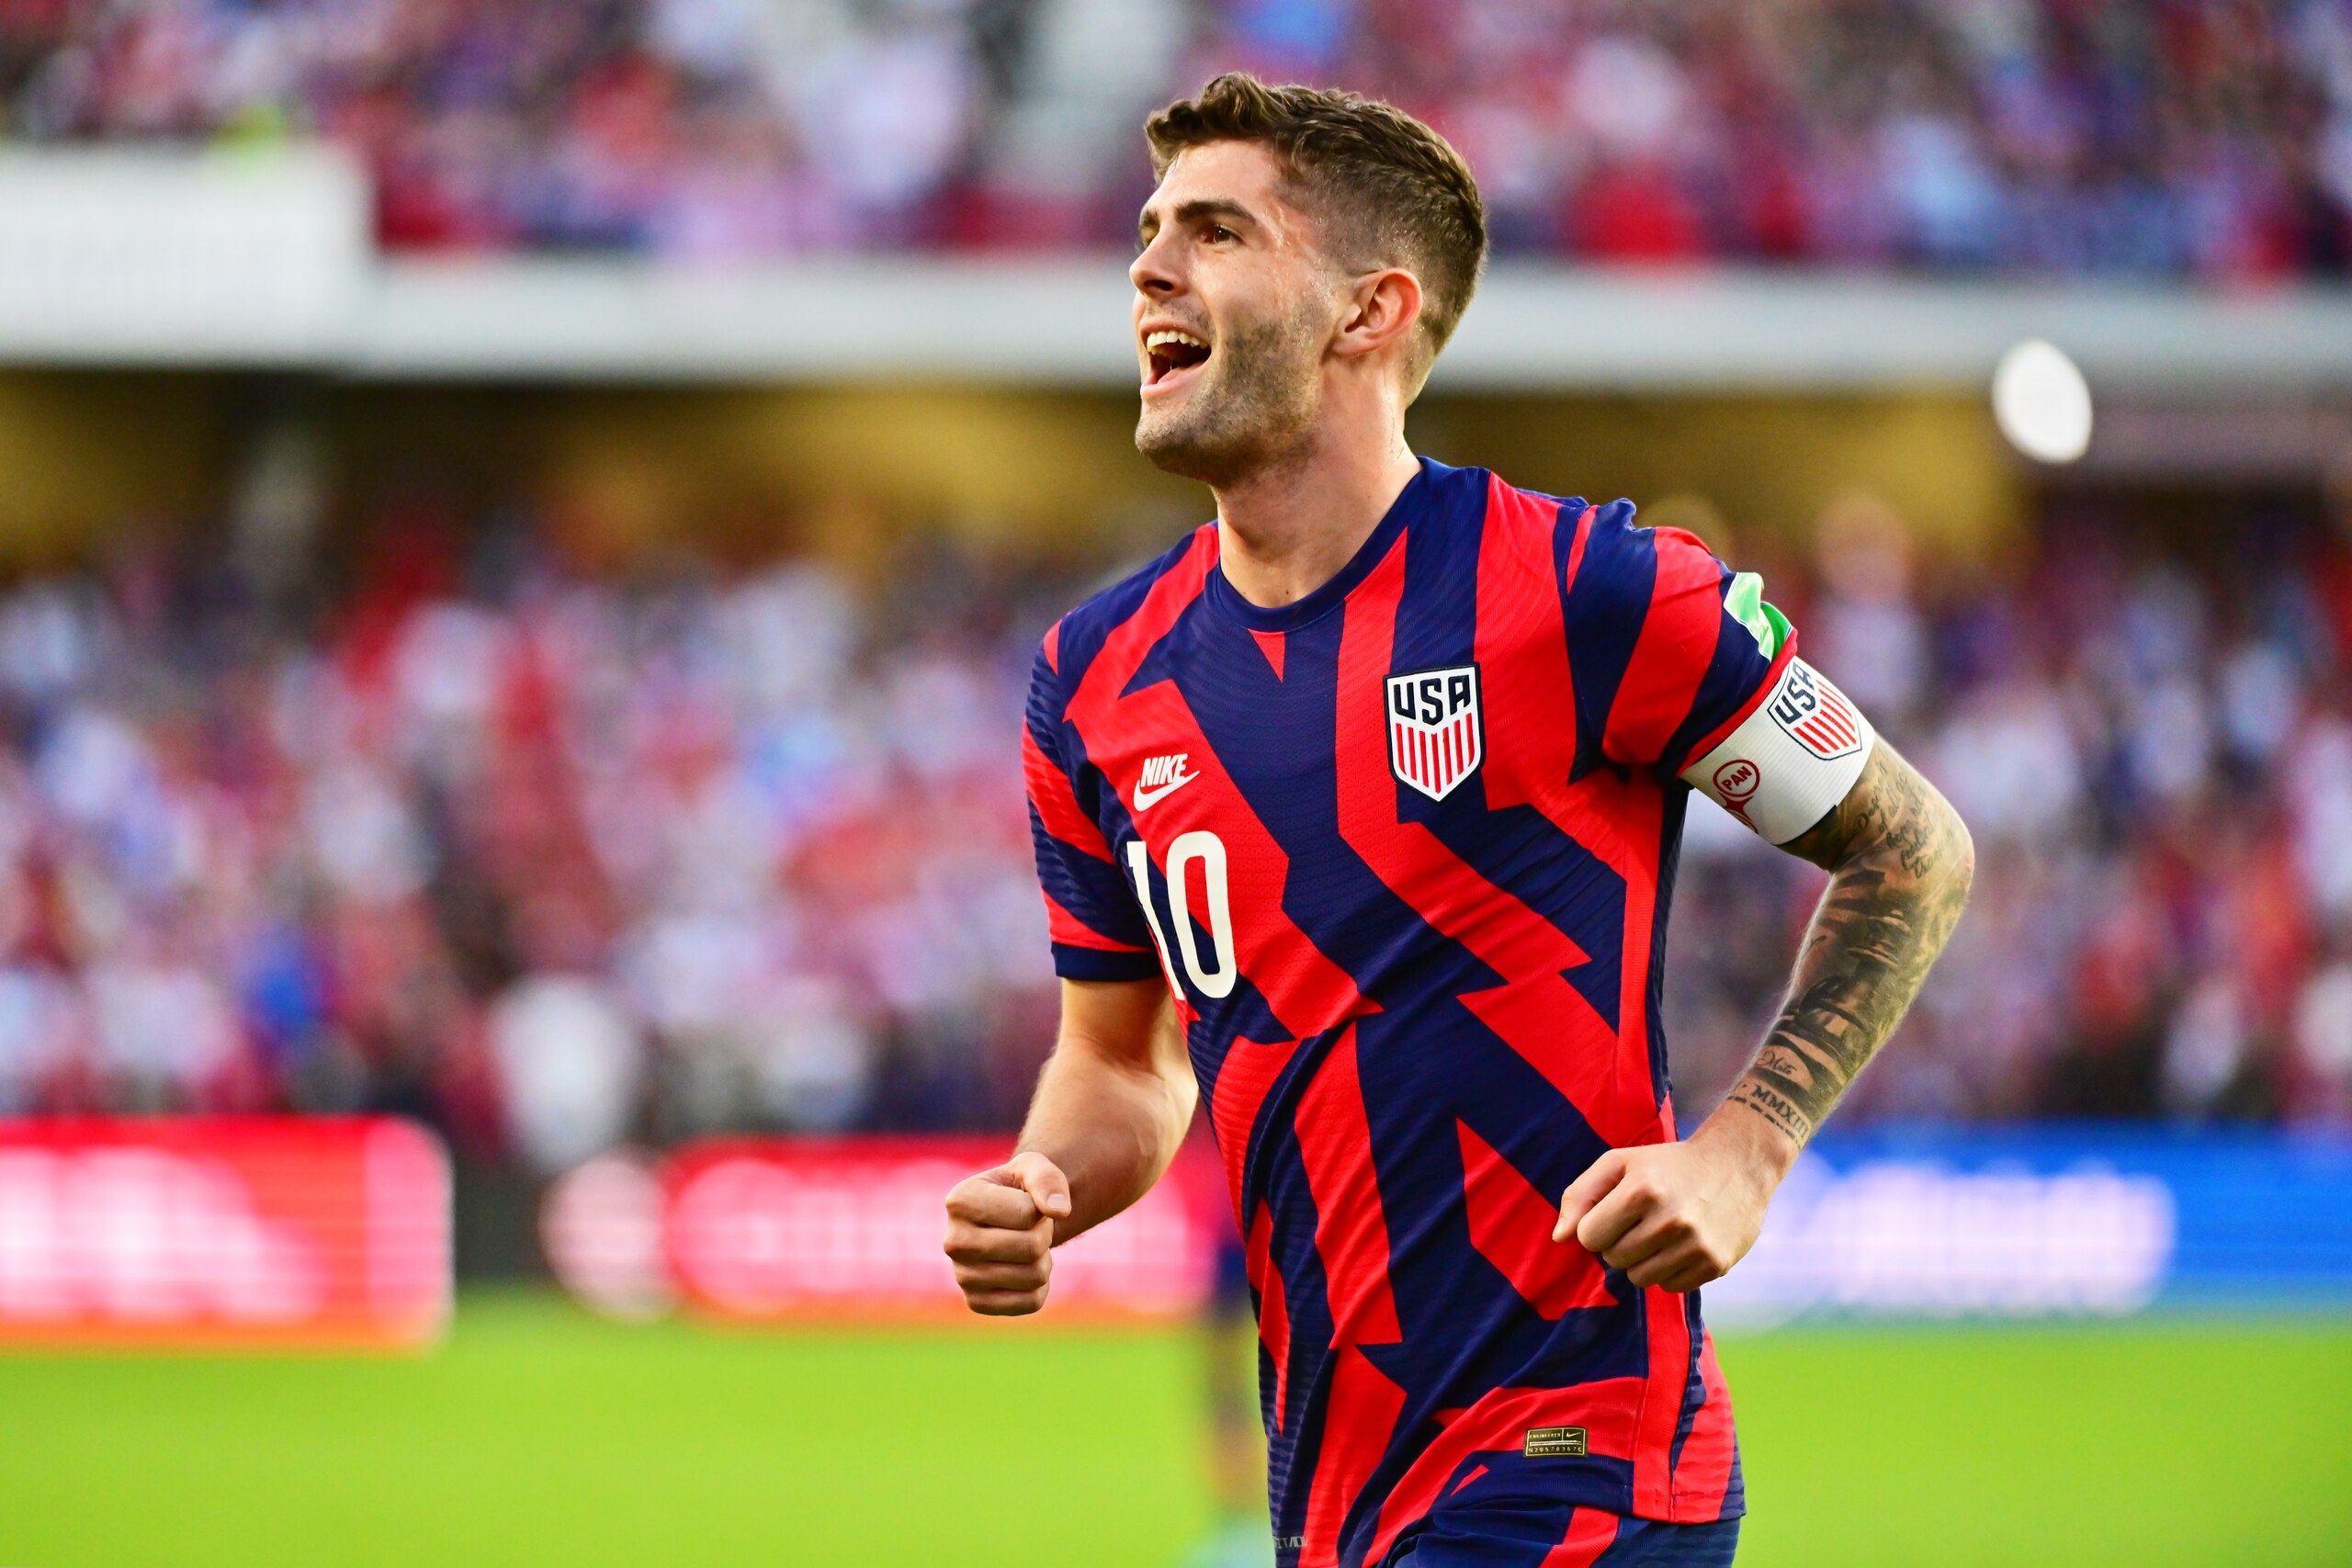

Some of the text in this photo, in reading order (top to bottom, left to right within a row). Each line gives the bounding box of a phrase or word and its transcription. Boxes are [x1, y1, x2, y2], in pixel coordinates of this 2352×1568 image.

[1393, 674, 1471, 726] USA
[1774, 660, 1816, 725] USA
[1140, 753, 1188, 787] NIKE
[1721, 765, 1753, 791] PAN
[1126, 829, 1238, 1002] 10
